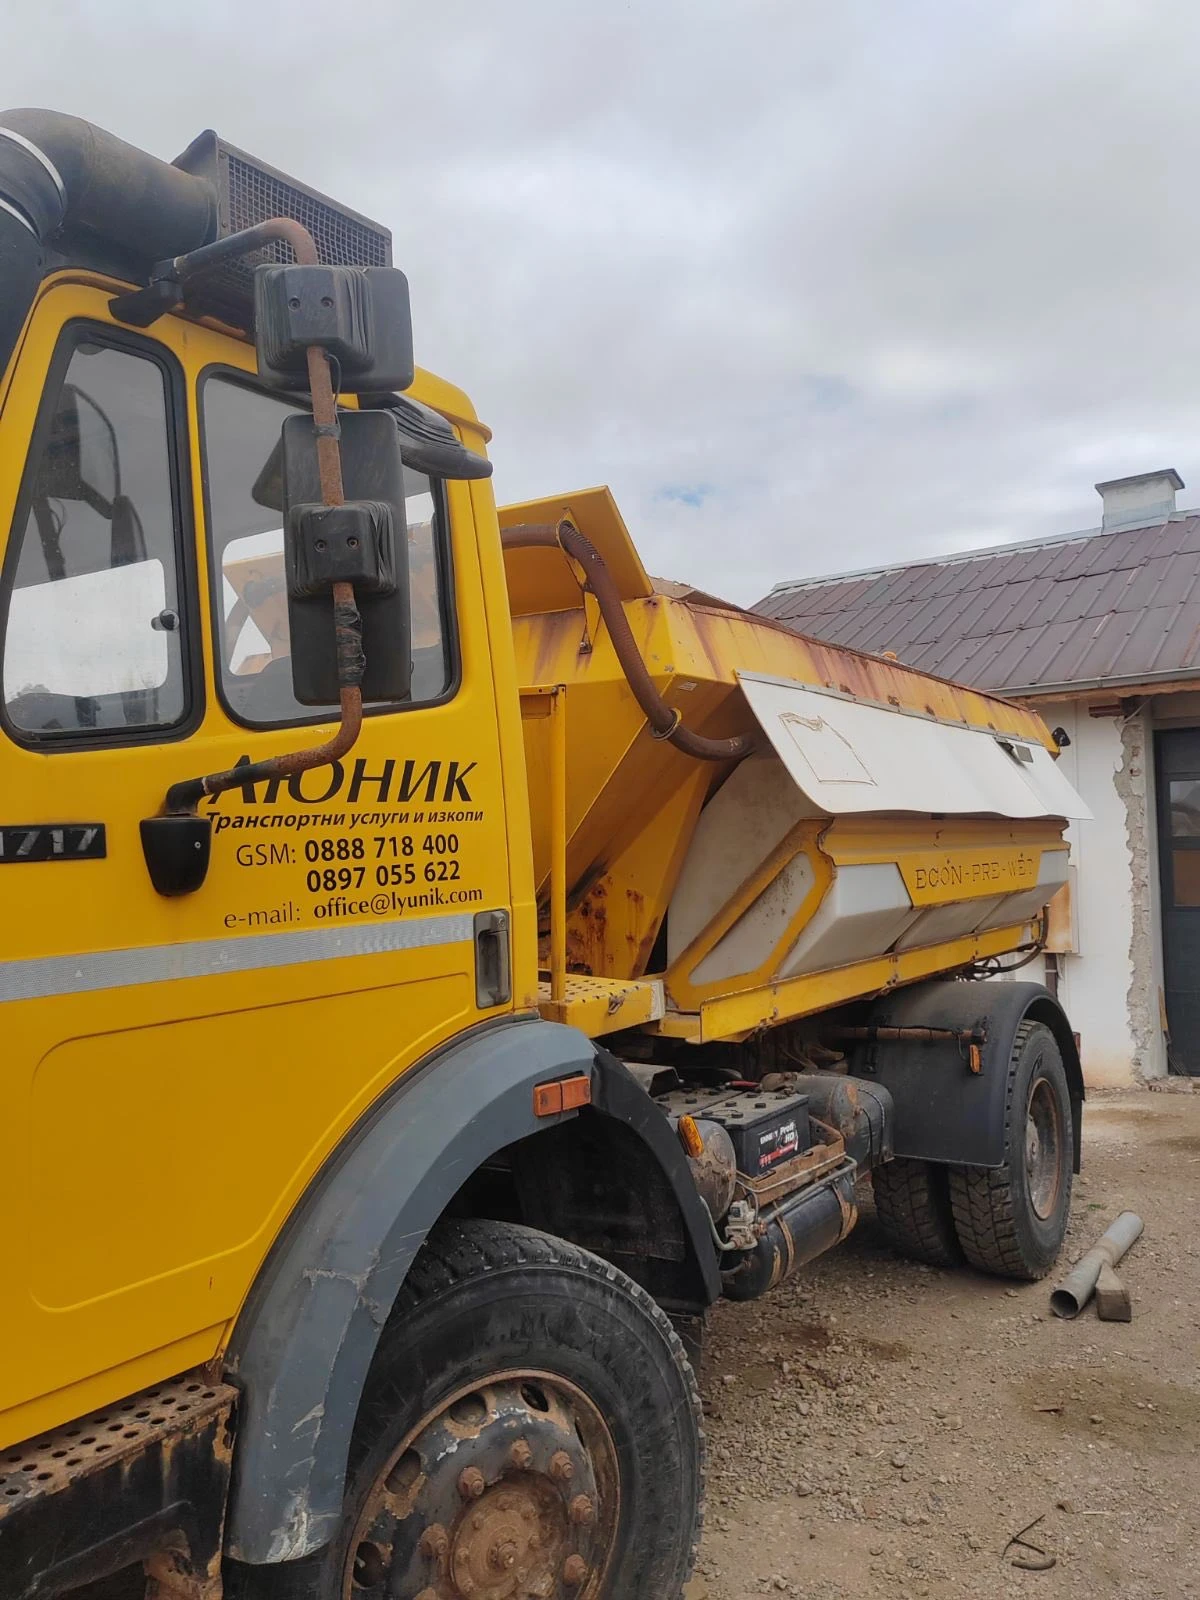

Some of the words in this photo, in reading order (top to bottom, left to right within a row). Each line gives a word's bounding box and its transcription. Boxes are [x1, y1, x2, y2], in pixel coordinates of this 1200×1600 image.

[206, 812, 345, 834] Транспортни
[350, 810, 409, 829] услуги
[413, 812, 424, 823] и
[427, 809, 484, 823] изкопи
[236, 843, 297, 867] GSM:
[304, 838, 365, 863] 0888
[373, 836, 414, 859] 718
[422, 833, 459, 855] 400
[306, 866, 366, 892] 0897
[376, 863, 416, 887] 055
[423, 860, 460, 883] 622
[223, 901, 301, 928] e-mail:
[313, 887, 483, 919] office@lyunik.com
